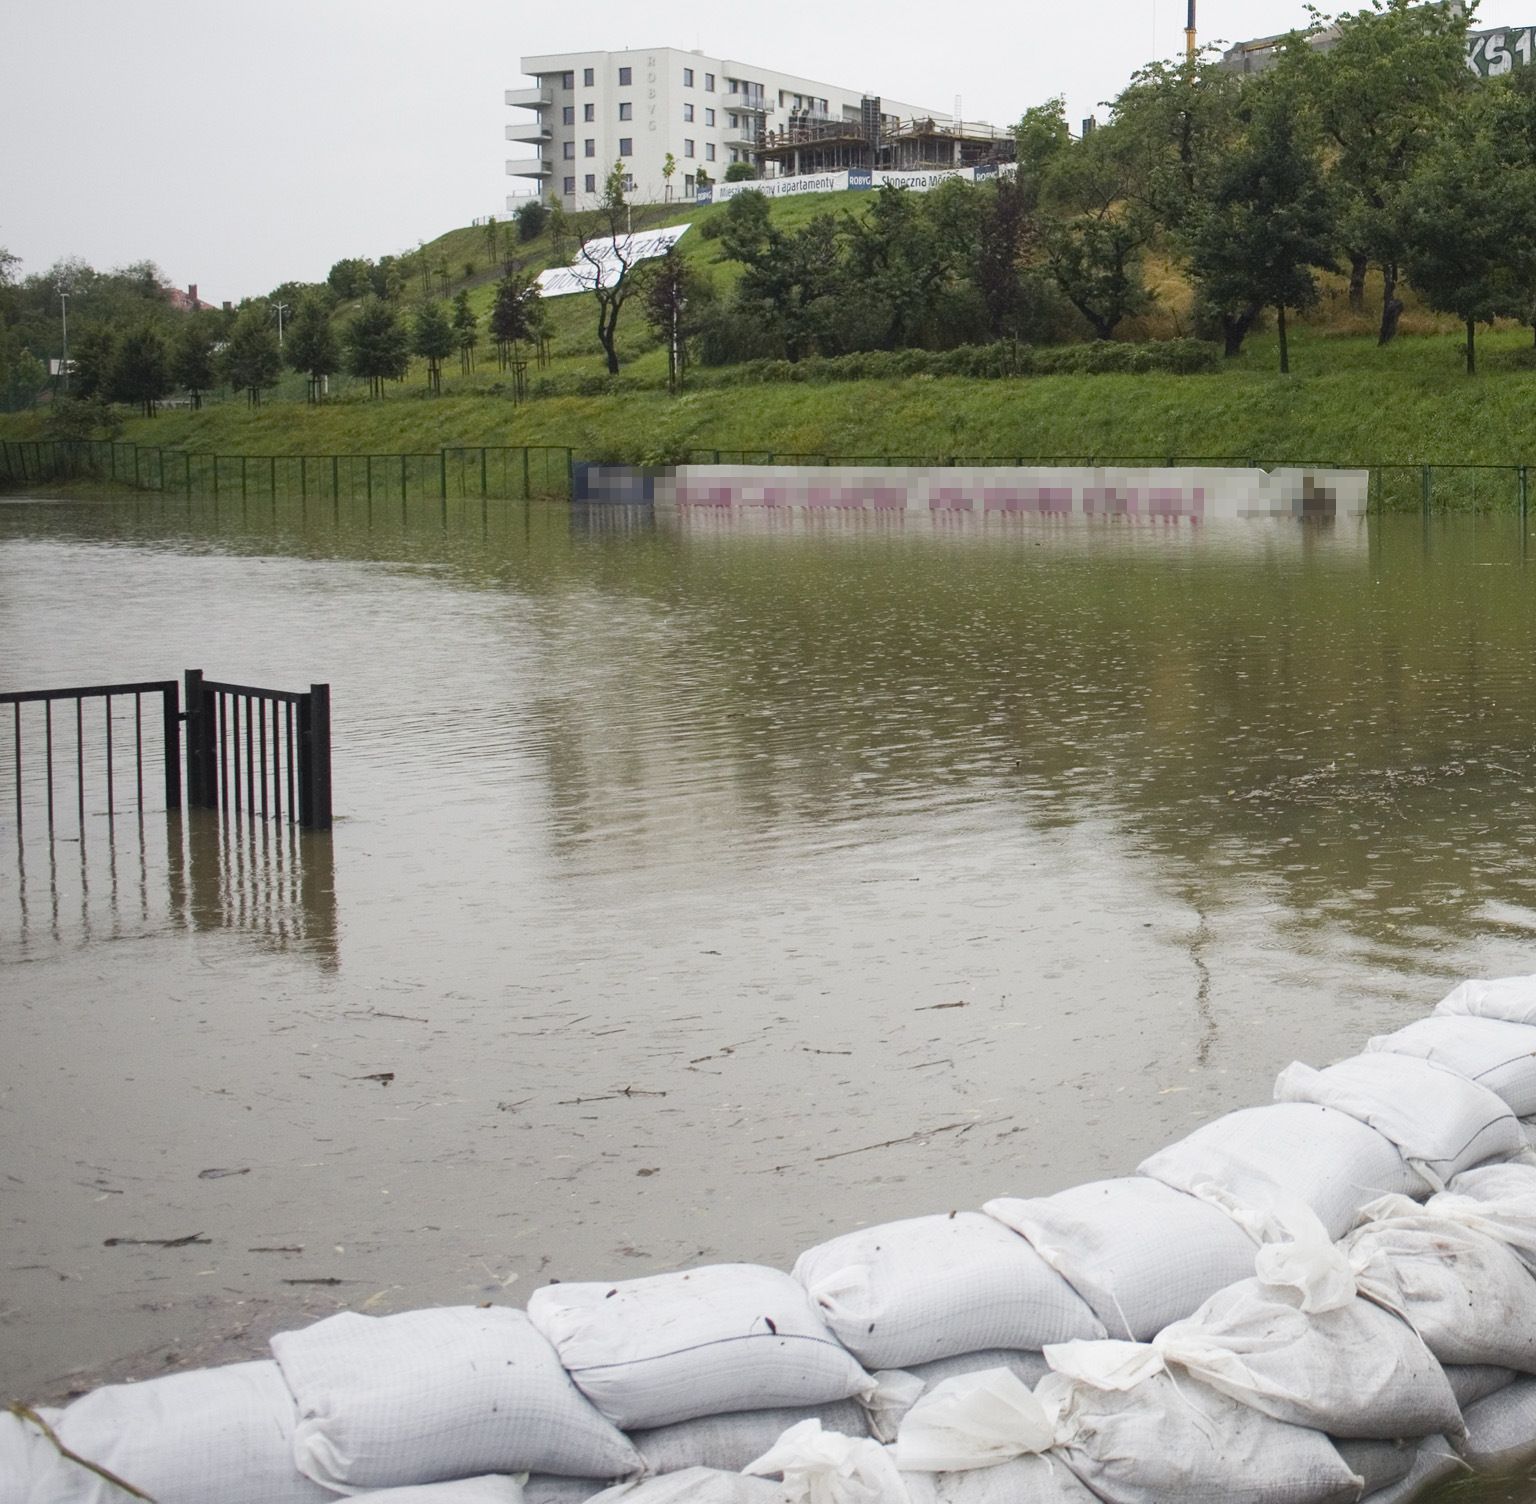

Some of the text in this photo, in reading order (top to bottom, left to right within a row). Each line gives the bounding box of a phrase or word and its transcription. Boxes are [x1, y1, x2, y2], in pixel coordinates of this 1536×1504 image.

[647, 56, 657, 132] ROBYG
[781, 176, 834, 195] apartamenty
[849, 175, 872, 186] ROBYG
